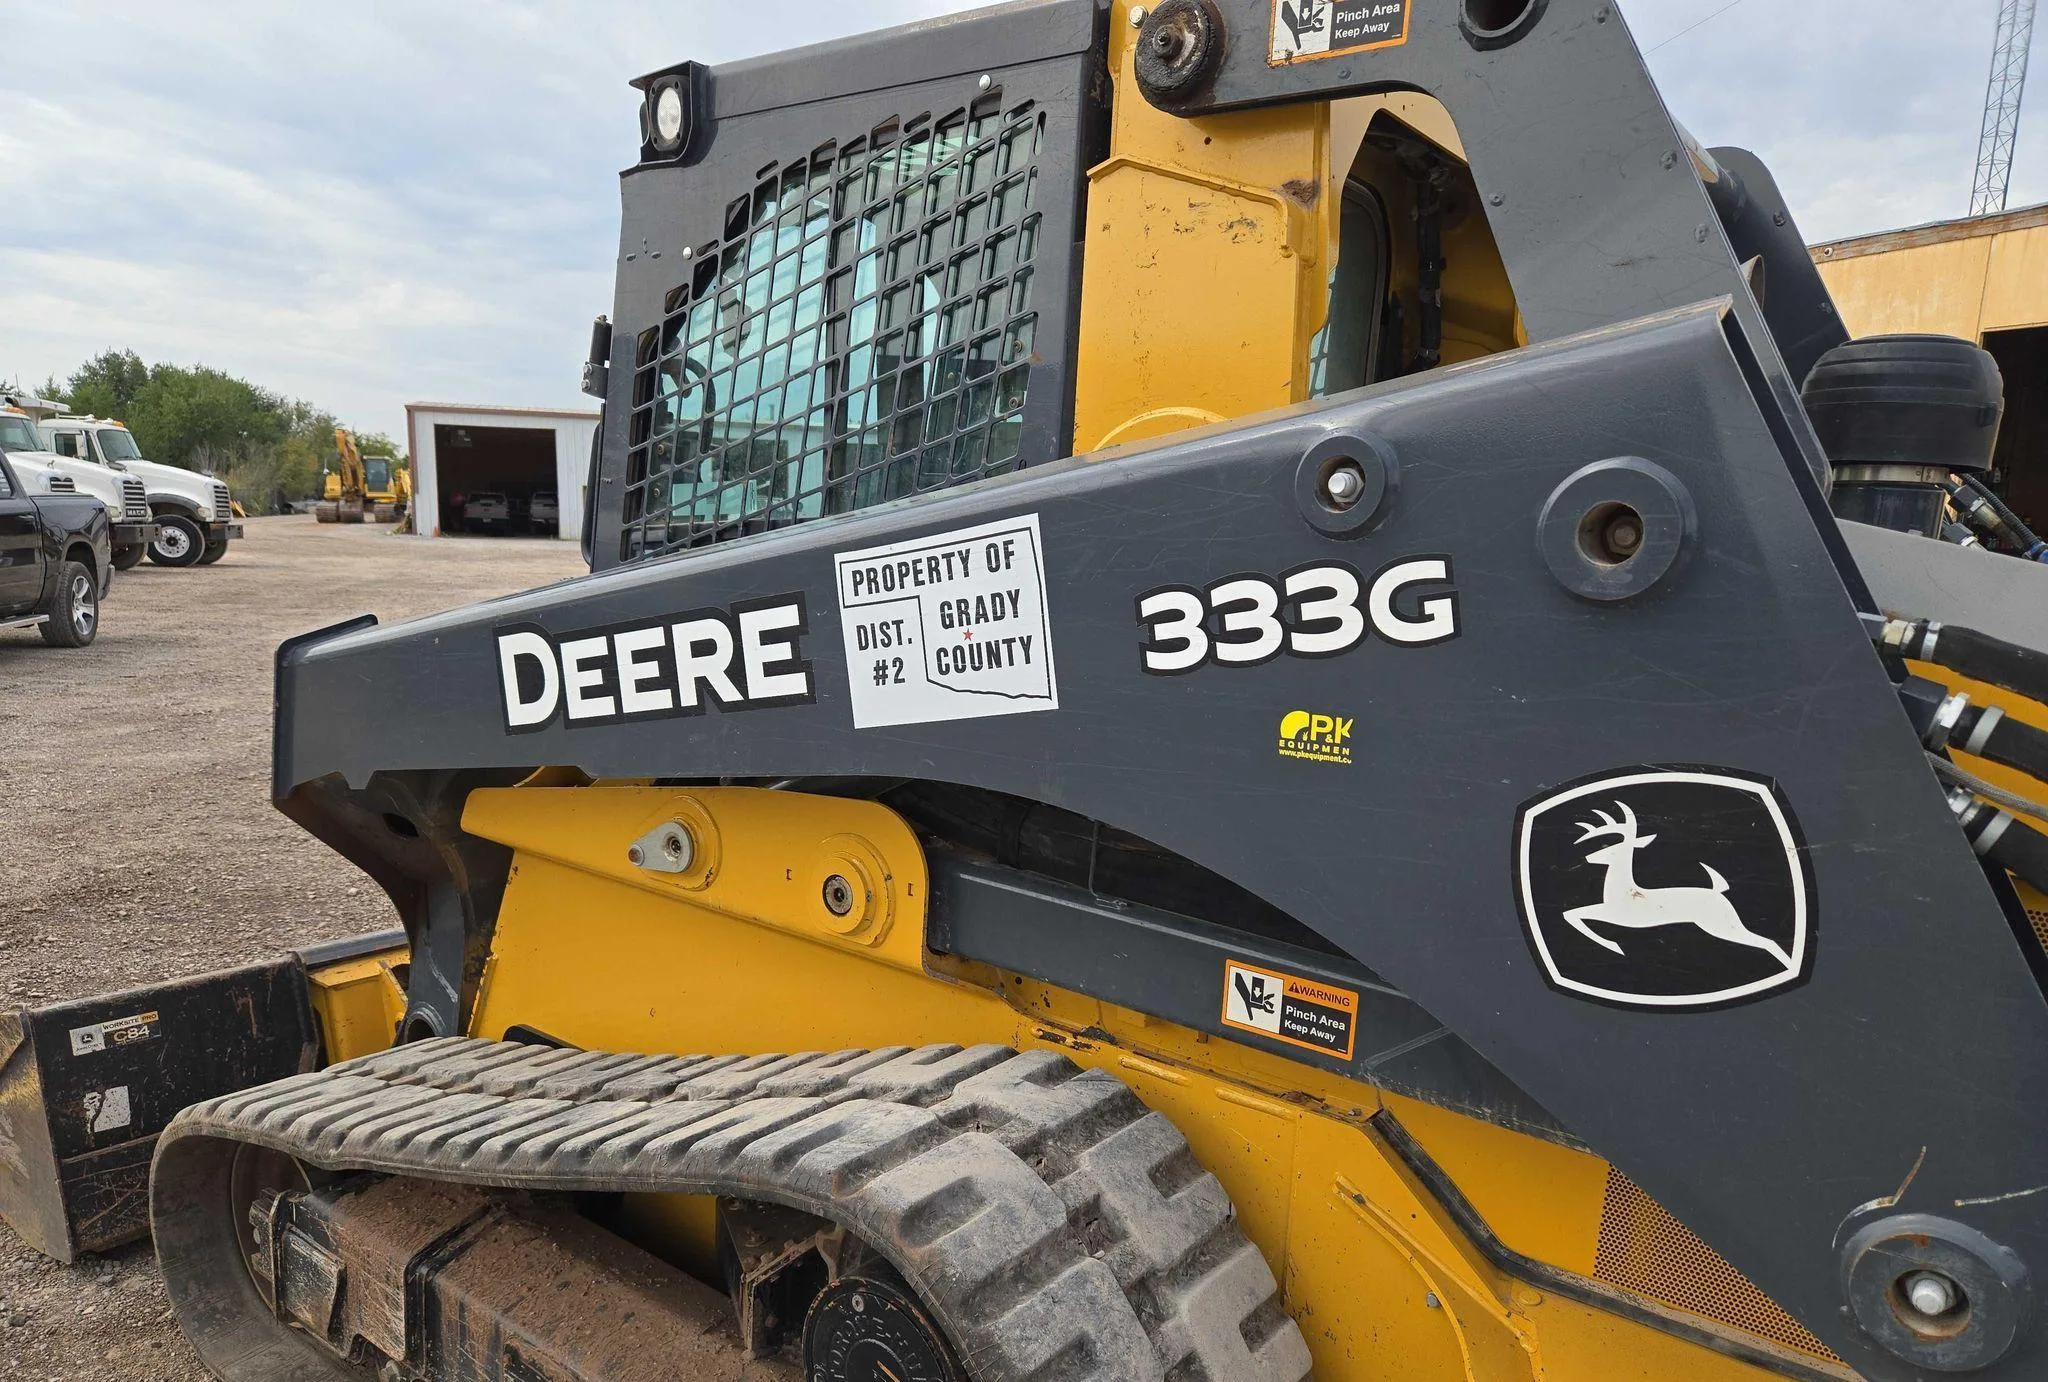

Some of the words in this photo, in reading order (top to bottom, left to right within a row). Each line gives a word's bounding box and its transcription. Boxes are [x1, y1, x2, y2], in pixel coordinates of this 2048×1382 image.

[1336, 8, 1369, 24] Pinch
[1372, 3, 1401, 17] Area
[1334, 27, 1360, 39] Keep
[1362, 22, 1390, 35] Away
[851, 548, 971, 597] PROPERTY
[985, 539, 1016, 573] OF
[940, 589, 1021, 630] GRADY
[1141, 560, 1455, 670] 333G
[856, 619, 913, 652] DIST.
[497, 604, 808, 727] DEERE
[936, 634, 1034, 676] COUNTY
[872, 657, 906, 686] #2
[1299, 985, 1350, 1006] WARNING
[102, 1017, 139, 1030] WORKSITE
[141, 1013, 157, 1022] PRO
[1284, 1019, 1309, 1035] Keep
[1310, 1027, 1336, 1043] Away
[1286, 1005, 1317, 1023] Pinch
[1319, 1014, 1346, 1031] Area
[113, 1025, 150, 1042] C84
